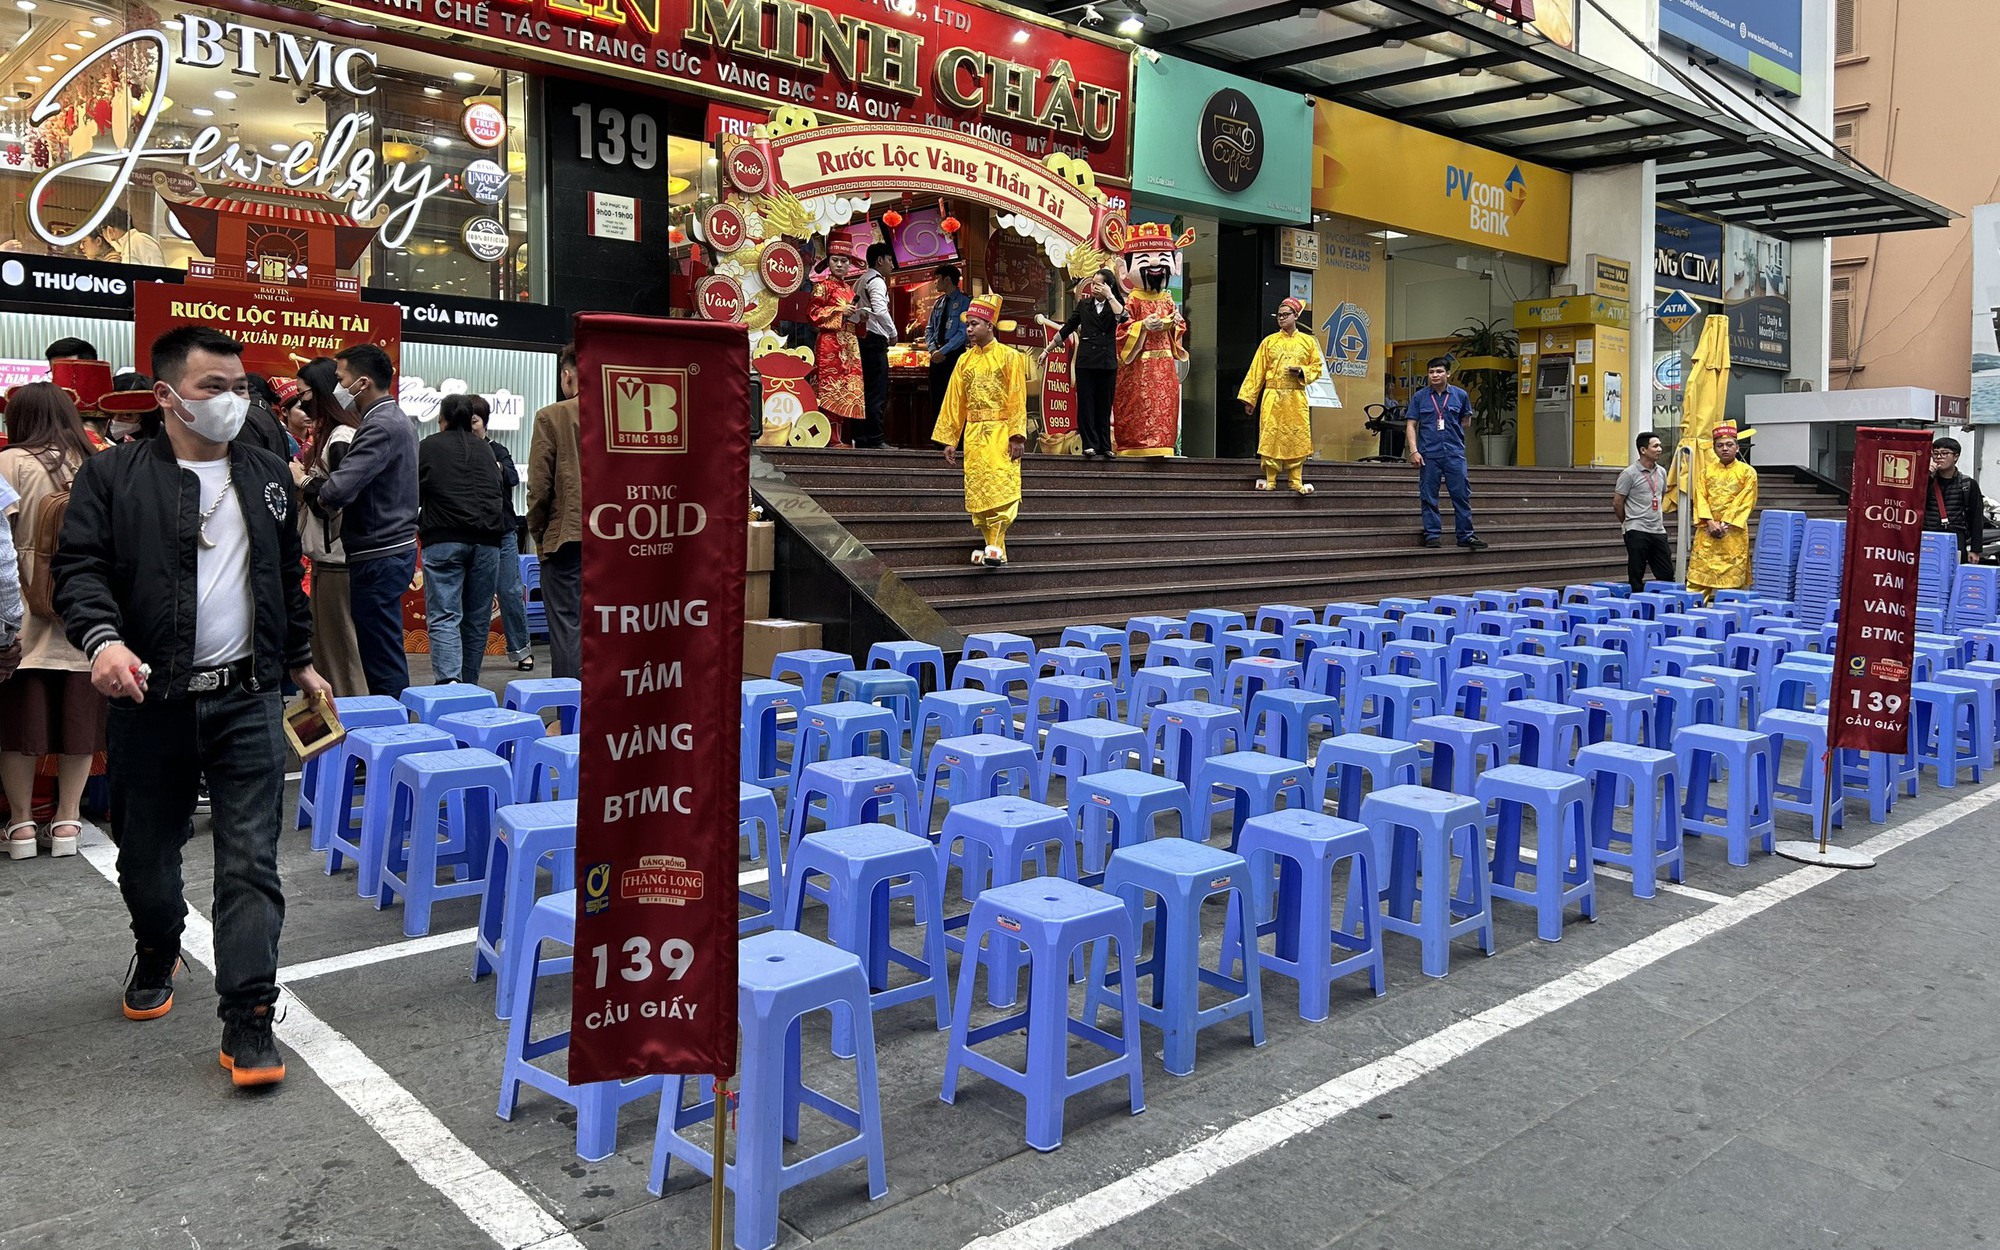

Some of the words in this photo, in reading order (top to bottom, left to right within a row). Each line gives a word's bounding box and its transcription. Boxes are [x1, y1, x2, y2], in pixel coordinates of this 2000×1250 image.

[933, 5, 972, 34] LTD)
[176, 13, 378, 96] BTMC
[434, 0, 490, 28] CHẾ
[501, 12, 551, 41] TÁC
[563, 26, 647, 63] TRANG
[656, 48, 702, 76] SỨC
[717, 61, 770, 92] VÀNG
[778, 77, 816, 103] BẠC
[836, 85, 860, 112] ĐÁ
[865, 97, 901, 121] QUÝ
[925, 112, 953, 130] KIM
[959, 121, 1012, 147] CƯƠNG
[1026, 134, 1048, 154] MỸ
[684, 0, 925, 96] MINH
[932, 47, 1121, 142] CHÂU
[474, 118, 496, 129] TRUE
[474, 127, 497, 138] GOLD
[28, 28, 452, 249] Jewelry
[572, 102, 657, 170] 139
[468, 171, 502, 185] UNIQUE
[734, 160, 763, 177] Rước
[178, 178, 192, 187] XINH
[816, 146, 877, 176] Rước
[882, 143, 920, 172] Lộc
[925, 146, 979, 183] Vàng
[984, 160, 1031, 200] Thần
[1037, 184, 1065, 220] Tài
[1446, 165, 1505, 211] PVcom
[477, 221, 499, 232] BTMC
[711, 216, 740, 239] Lộc
[1469, 204, 1510, 237] Bank
[478, 246, 499, 256] BRAND
[1325, 243, 1336, 256] 10
[1339, 246, 1371, 262] YEARS
[766, 257, 799, 282] Rồng
[1325, 258, 1370, 272] ANNIVERSARY
[32, 271, 127, 295] THƯƠNG
[277, 286, 289, 295] TÍN
[254, 293, 274, 301] MINH
[704, 291, 739, 316] Vàng
[171, 300, 231, 320] RƯỚC
[237, 305, 276, 327] LỘC
[281, 309, 334, 331] THẦN
[339, 314, 370, 333] TÀI
[413, 303, 450, 323] CỦA
[454, 310, 499, 327] BTMC
[1541, 313, 1562, 322] Bank
[1607, 306, 1624, 320] ATM
[1663, 303, 1687, 313] ATM
[1667, 316, 1683, 324] 24/7
[1759, 313, 1767, 324] For
[1767, 314, 1778, 328] Daily
[240, 329, 278, 345] XUÂN
[281, 333, 305, 349] ĐẠI
[308, 334, 343, 350] PHÁT
[771, 397, 794, 415] 20
[1050, 399, 1067, 411] LONG
[1948, 400, 1960, 415] ATM
[1049, 416, 1070, 428] 999.9
[618, 433, 649, 444] BTMC
[653, 434, 679, 444] 1989
[626, 484, 677, 500] BTMC
[1884, 498, 1905, 508] BTMC
[588, 502, 707, 540] GOLD
[1865, 505, 1918, 525] GOLD
[628, 542, 674, 557] CENTER
[1864, 546, 1915, 565] TRUNG
[1873, 573, 1904, 590] TÂM
[594, 599, 709, 634] TRUNG
[1864, 597, 1906, 617] VÀNG
[1860, 626, 1904, 644] BTMC
[620, 660, 683, 697] TÂM
[1851, 689, 1901, 714] 139
[1845, 714, 1870, 727] CẦU
[1875, 720, 1902, 731] GIẤY
[605, 723, 693, 761] VÀNG
[603, 785, 693, 823] BTMC
[624, 872, 667, 887] THĂNG
[669, 875, 702, 888] LONG
[592, 936, 695, 989] 139
[585, 999, 629, 1030] CẦU
[640, 995, 698, 1021] GIẤY
